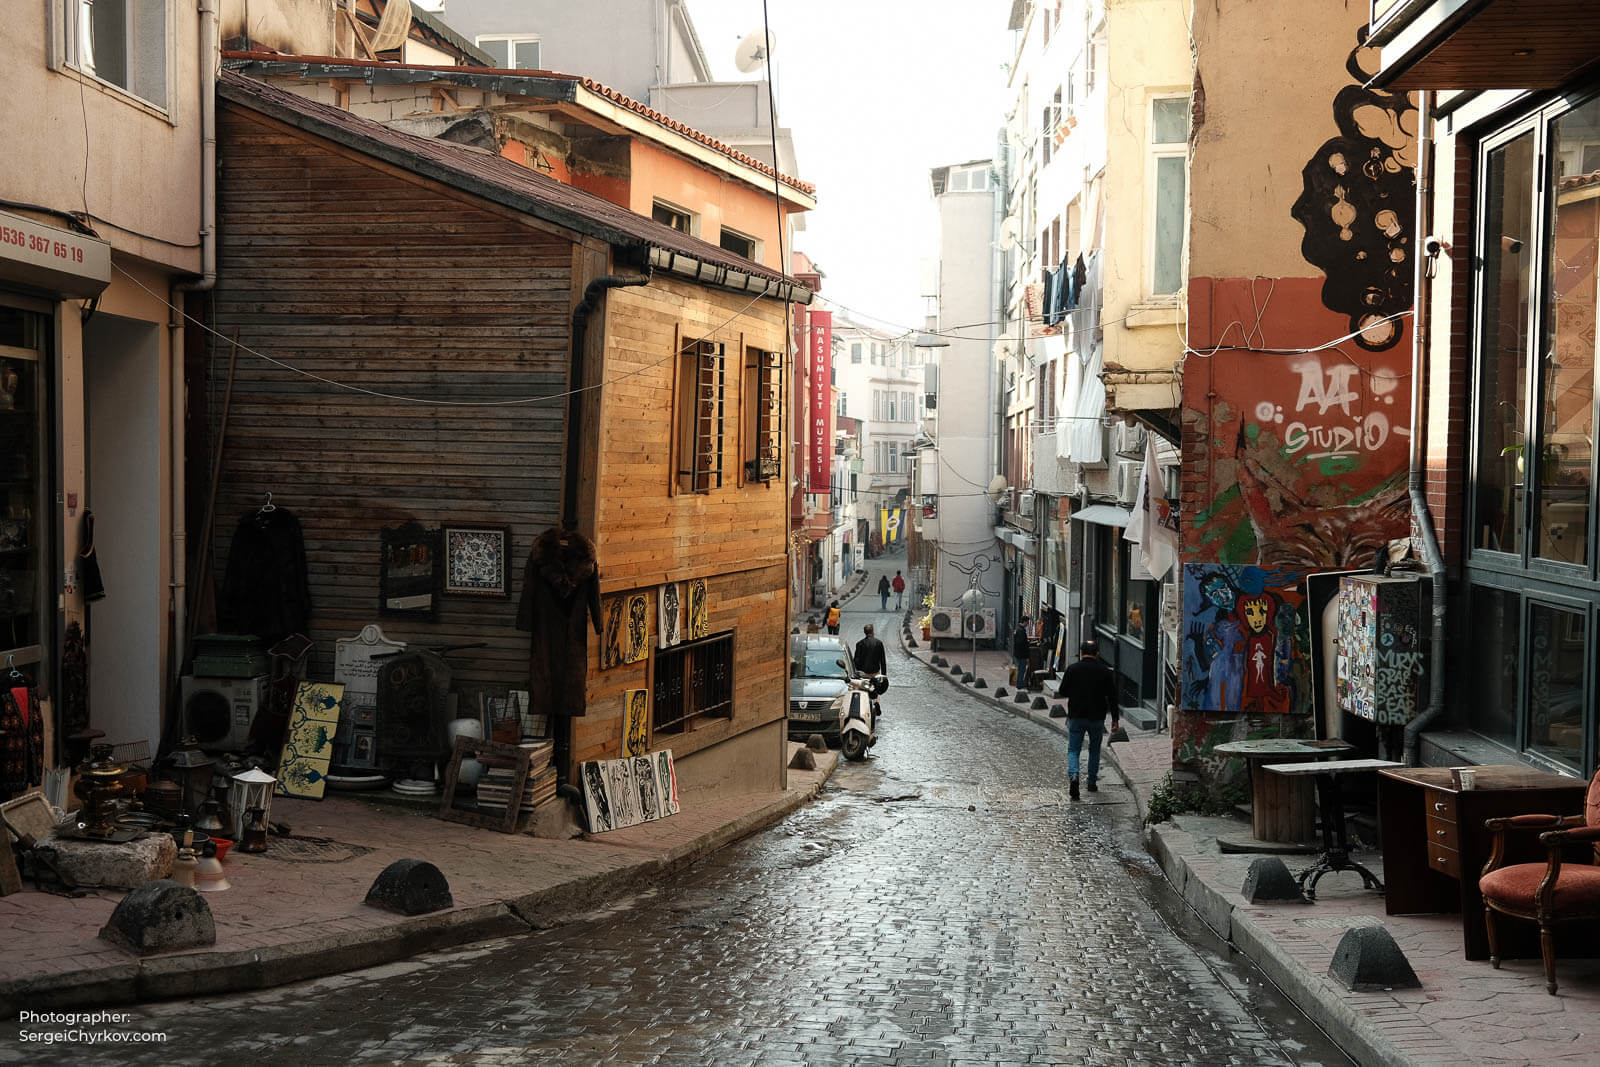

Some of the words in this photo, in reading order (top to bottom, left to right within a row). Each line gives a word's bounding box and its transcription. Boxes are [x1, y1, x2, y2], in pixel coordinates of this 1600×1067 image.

[29, 234, 50, 254] 367
[53, 241, 67, 258] 65
[71, 247, 83, 263] 19
